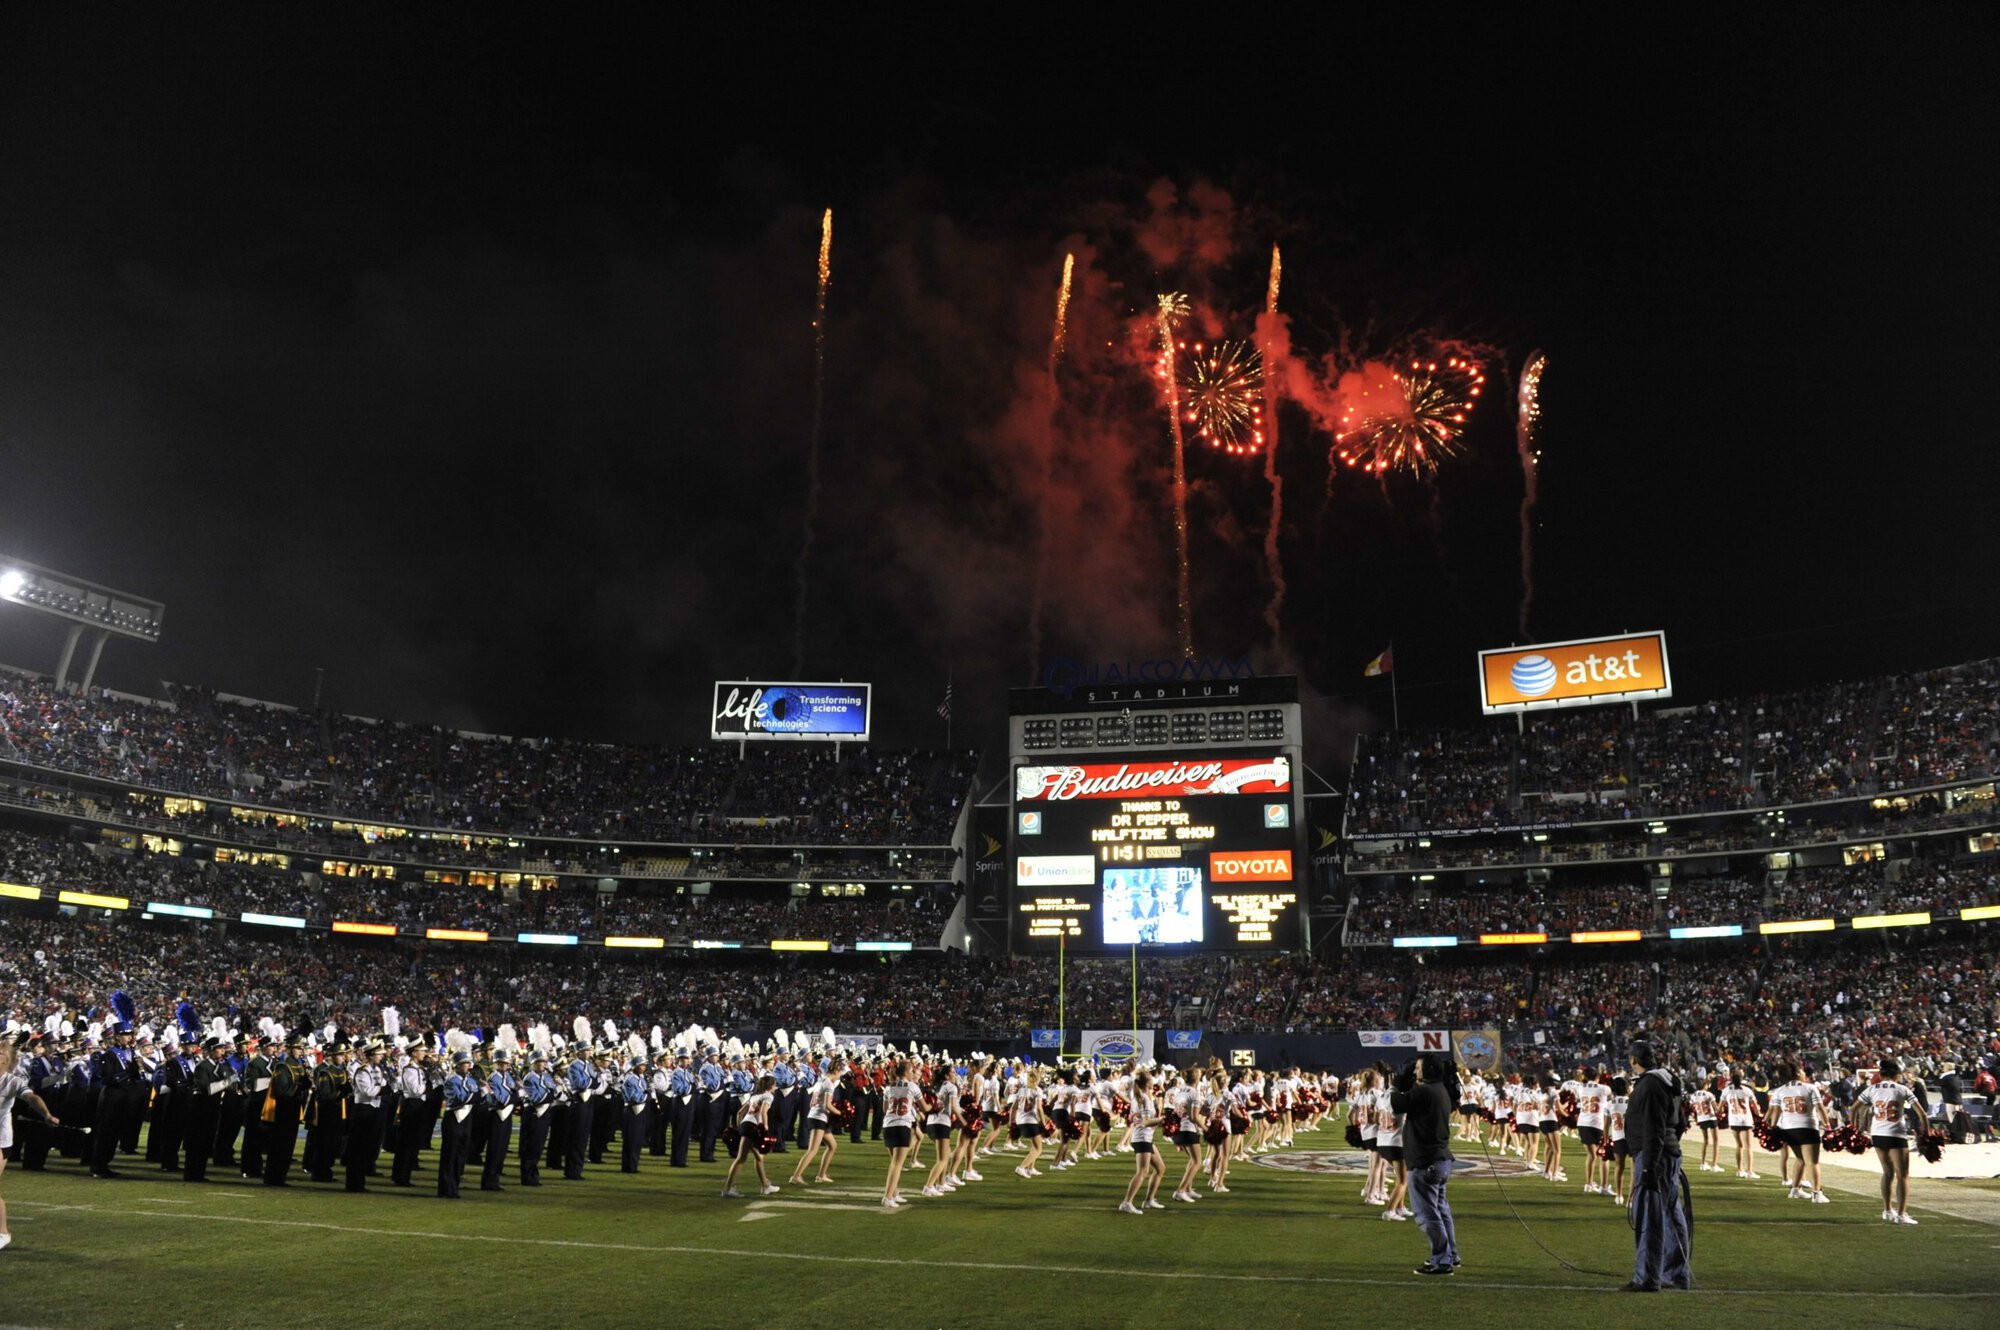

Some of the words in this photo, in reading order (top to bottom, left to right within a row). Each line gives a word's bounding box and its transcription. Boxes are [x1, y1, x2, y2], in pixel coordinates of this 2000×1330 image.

[1566, 650, 1642, 684] at&t
[1045, 655, 1255, 699] QUALCOMM
[800, 695, 861, 706] Transforming
[1088, 685, 1239, 701] STADIUM
[717, 688, 768, 730] life
[813, 704, 848, 712] science
[1041, 762, 1222, 800] Budweiser
[1121, 801, 1162, 812] THANKS
[1165, 801, 1180, 811] TO
[1112, 815, 1131, 826] DR
[1137, 813, 1189, 826] PEPPER
[1092, 828, 1167, 841] HALFTIME
[1176, 826, 1214, 839] SHOW
[975, 861, 1004, 872] Sprint
[1214, 859, 1288, 874] TOYOTA
[1311, 853, 1342, 865] Sprint
[1098, 1035, 1124, 1046] PACIFIC
[1423, 1032, 1442, 1049] N
[1233, 1050, 1253, 1065] 25
[1783, 1095, 1808, 1114] 36
[1874, 1100, 1899, 1122] 36
